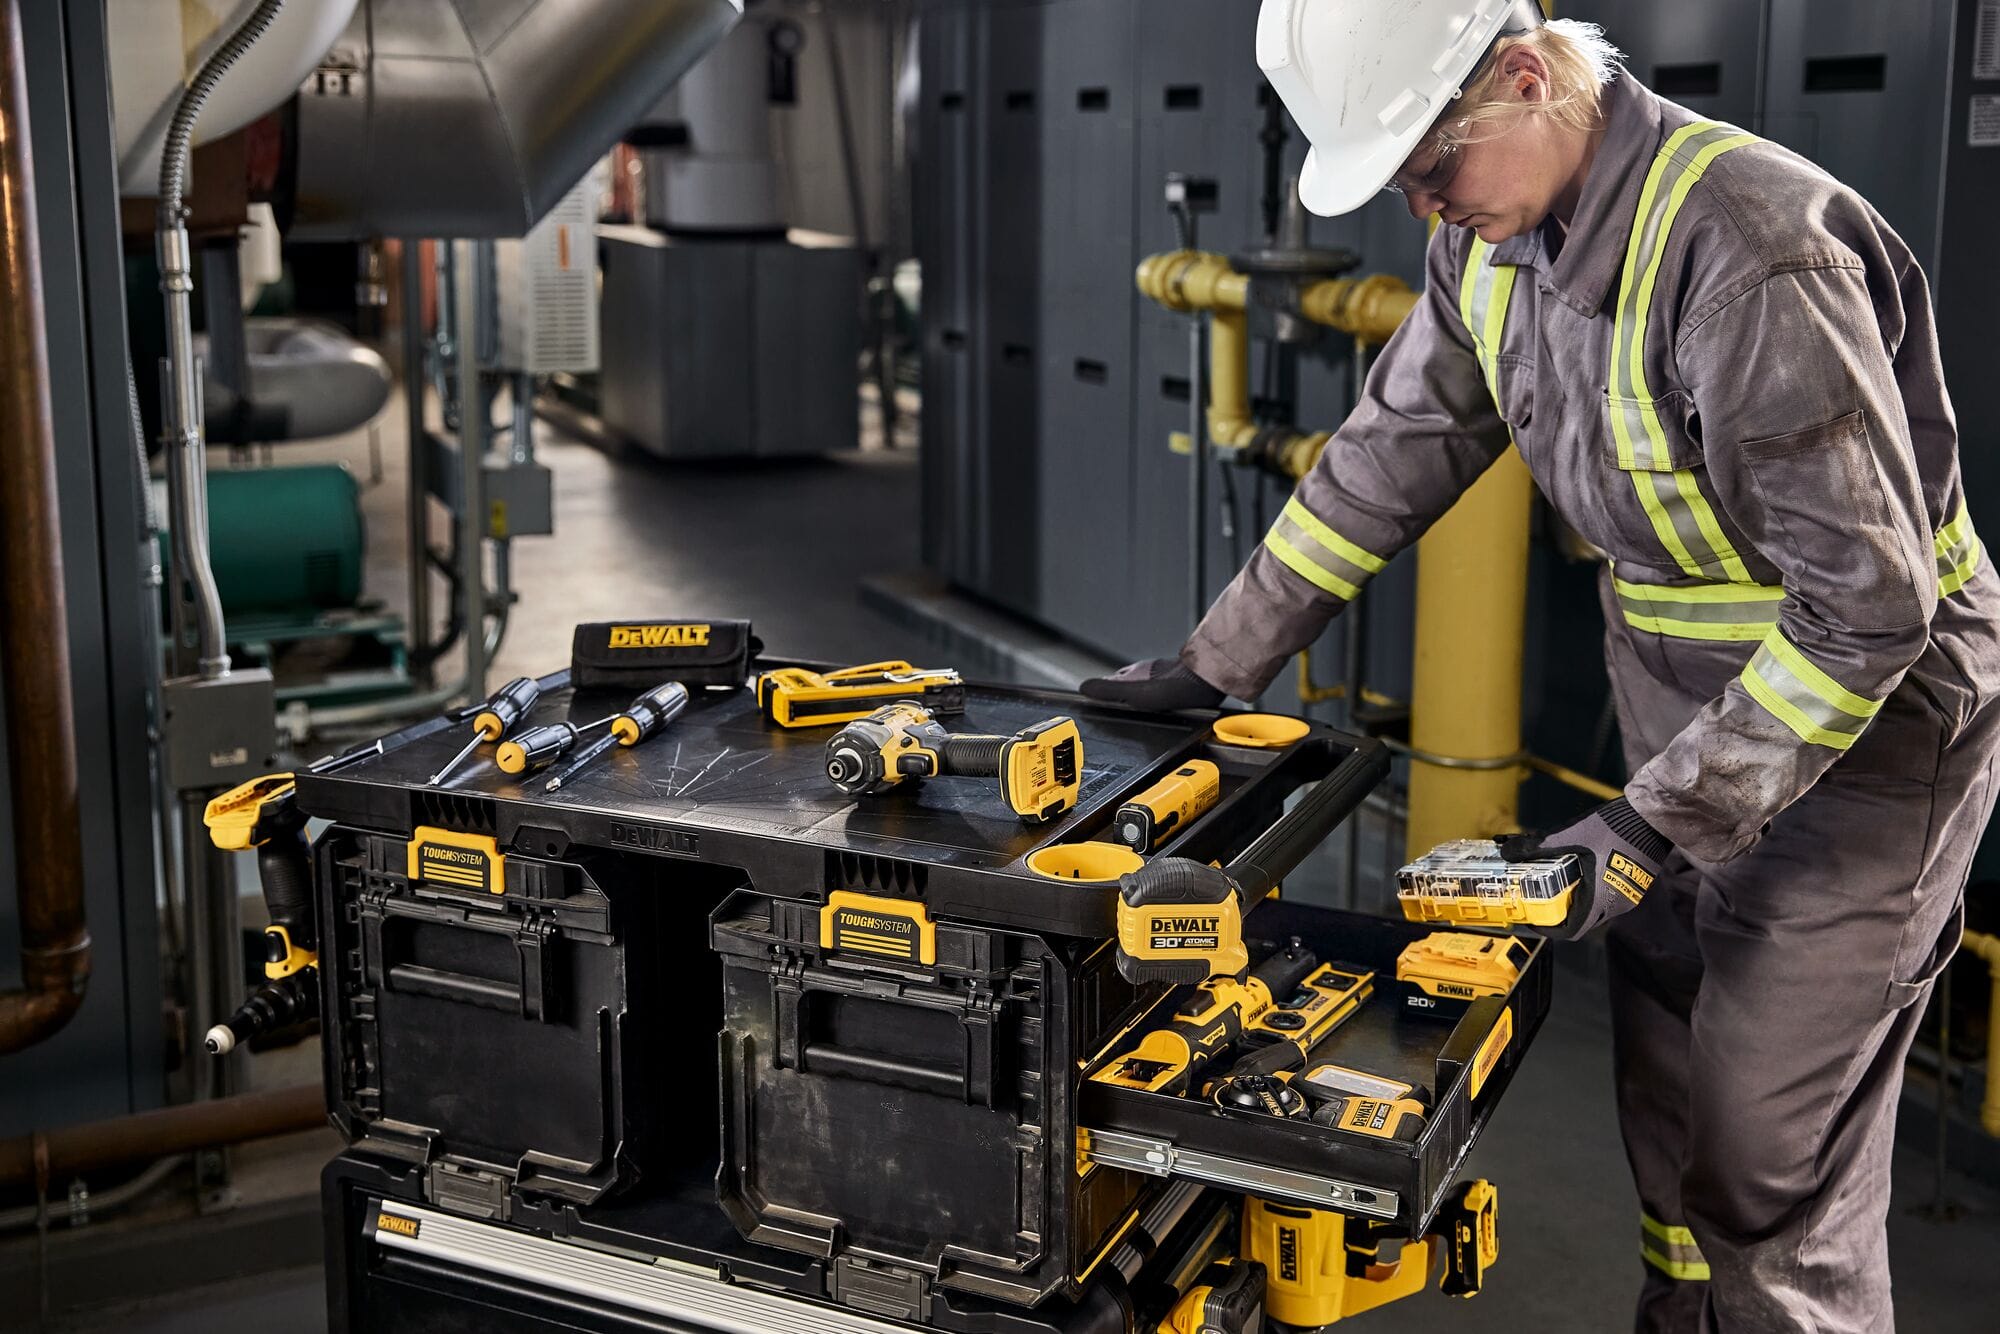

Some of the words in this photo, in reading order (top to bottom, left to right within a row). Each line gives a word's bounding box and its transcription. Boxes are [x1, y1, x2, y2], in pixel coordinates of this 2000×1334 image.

[608, 624, 711, 648] DEWALT
[610, 822, 700, 856] DEWALT
[423, 846, 483, 866] TOUGHSYSTEM
[839, 912, 912, 934] TOUGHSYSTEM
[1151, 917, 1219, 934] DEWALT
[1154, 937, 1182, 948] 30'
[1184, 937, 1216, 945] ATOMIC
[1437, 983, 1475, 997] DEWALT
[1407, 996, 1436, 1009] 20V
[1352, 1100, 1378, 1127] DEWALT
[1280, 1226, 1297, 1281] DEWALT
